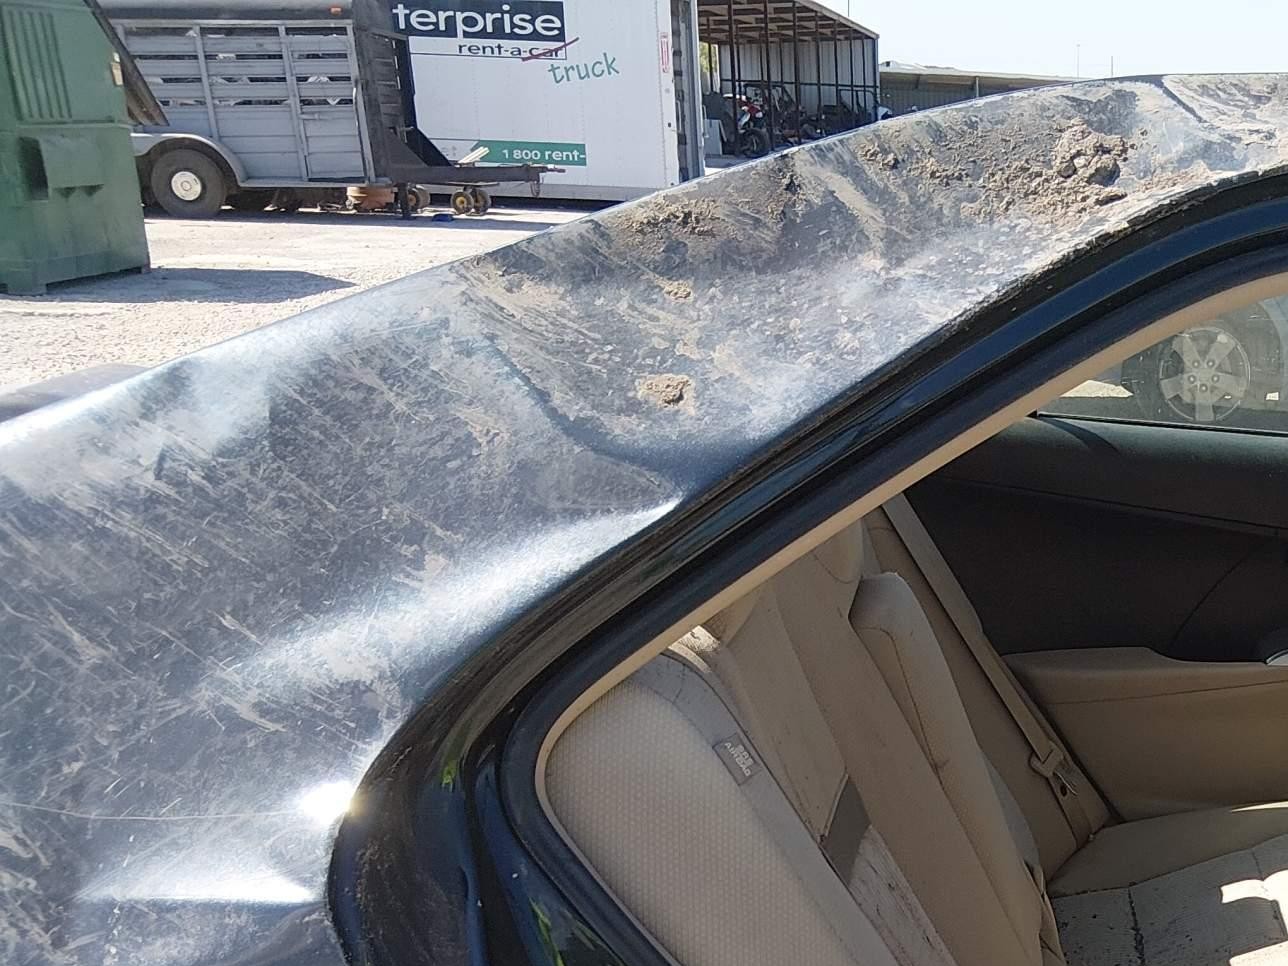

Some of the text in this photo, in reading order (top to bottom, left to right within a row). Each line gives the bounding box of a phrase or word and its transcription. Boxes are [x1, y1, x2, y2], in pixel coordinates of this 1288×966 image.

[391, 4, 562, 39] terprise
[547, 52, 620, 84] truck
[513, 149, 541, 160] 800
